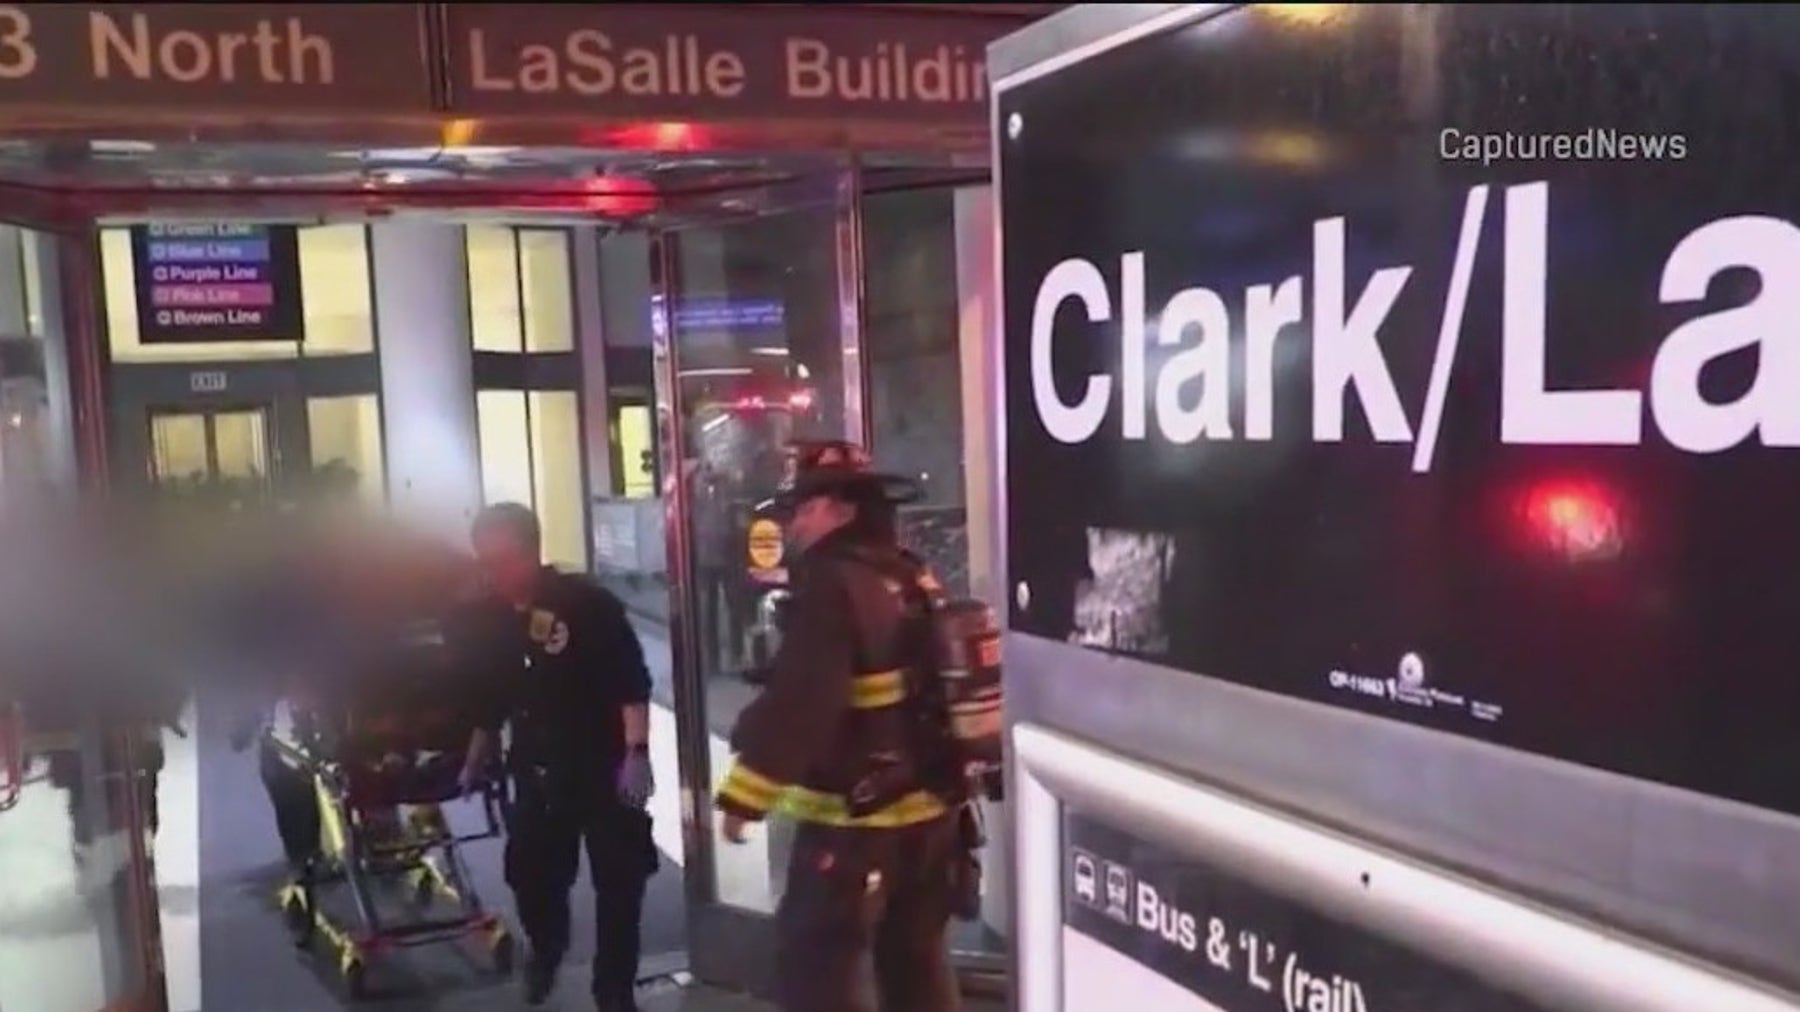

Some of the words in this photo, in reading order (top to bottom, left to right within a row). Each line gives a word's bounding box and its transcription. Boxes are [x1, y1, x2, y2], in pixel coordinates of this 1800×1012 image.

[0, 7, 37, 78] 3
[89, 10, 334, 85] North
[471, 29, 747, 97] LaSalle
[170, 243, 205, 258] Blue
[208, 242, 242, 257] Line
[171, 267, 220, 282] Purple
[223, 265, 258, 279] Line
[172, 287, 205, 301] Pink
[208, 287, 241, 301] Line
[174, 311, 224, 325] Brown
[227, 309, 261, 324] Line
[1030, 181, 1800, 472] Clark/La
[1137, 881, 1197, 951] Bus
[1206, 918, 1231, 970] &
